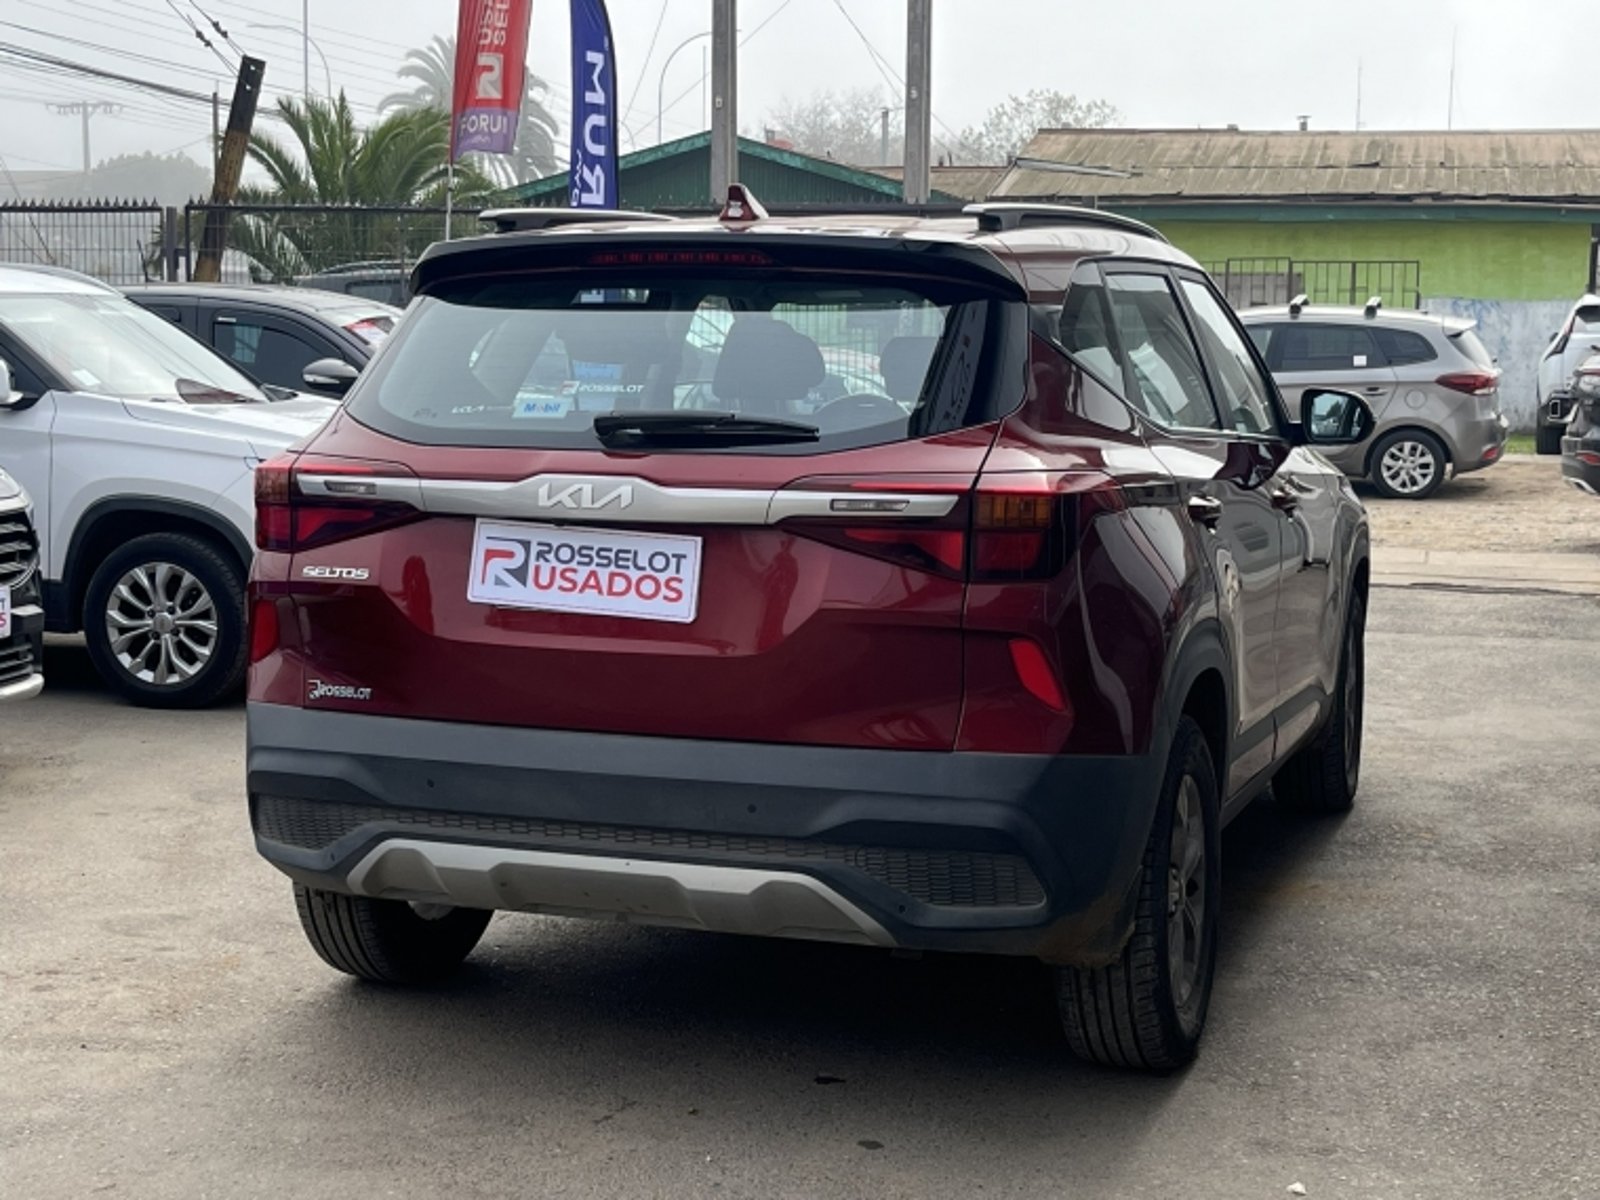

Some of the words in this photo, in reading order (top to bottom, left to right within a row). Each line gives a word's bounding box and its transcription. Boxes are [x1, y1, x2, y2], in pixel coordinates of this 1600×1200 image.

[538, 483, 634, 509] KIA
[535, 541, 687, 574] ROSSELOT
[303, 565, 370, 580] SELTOS
[533, 566, 684, 603] USADOS
